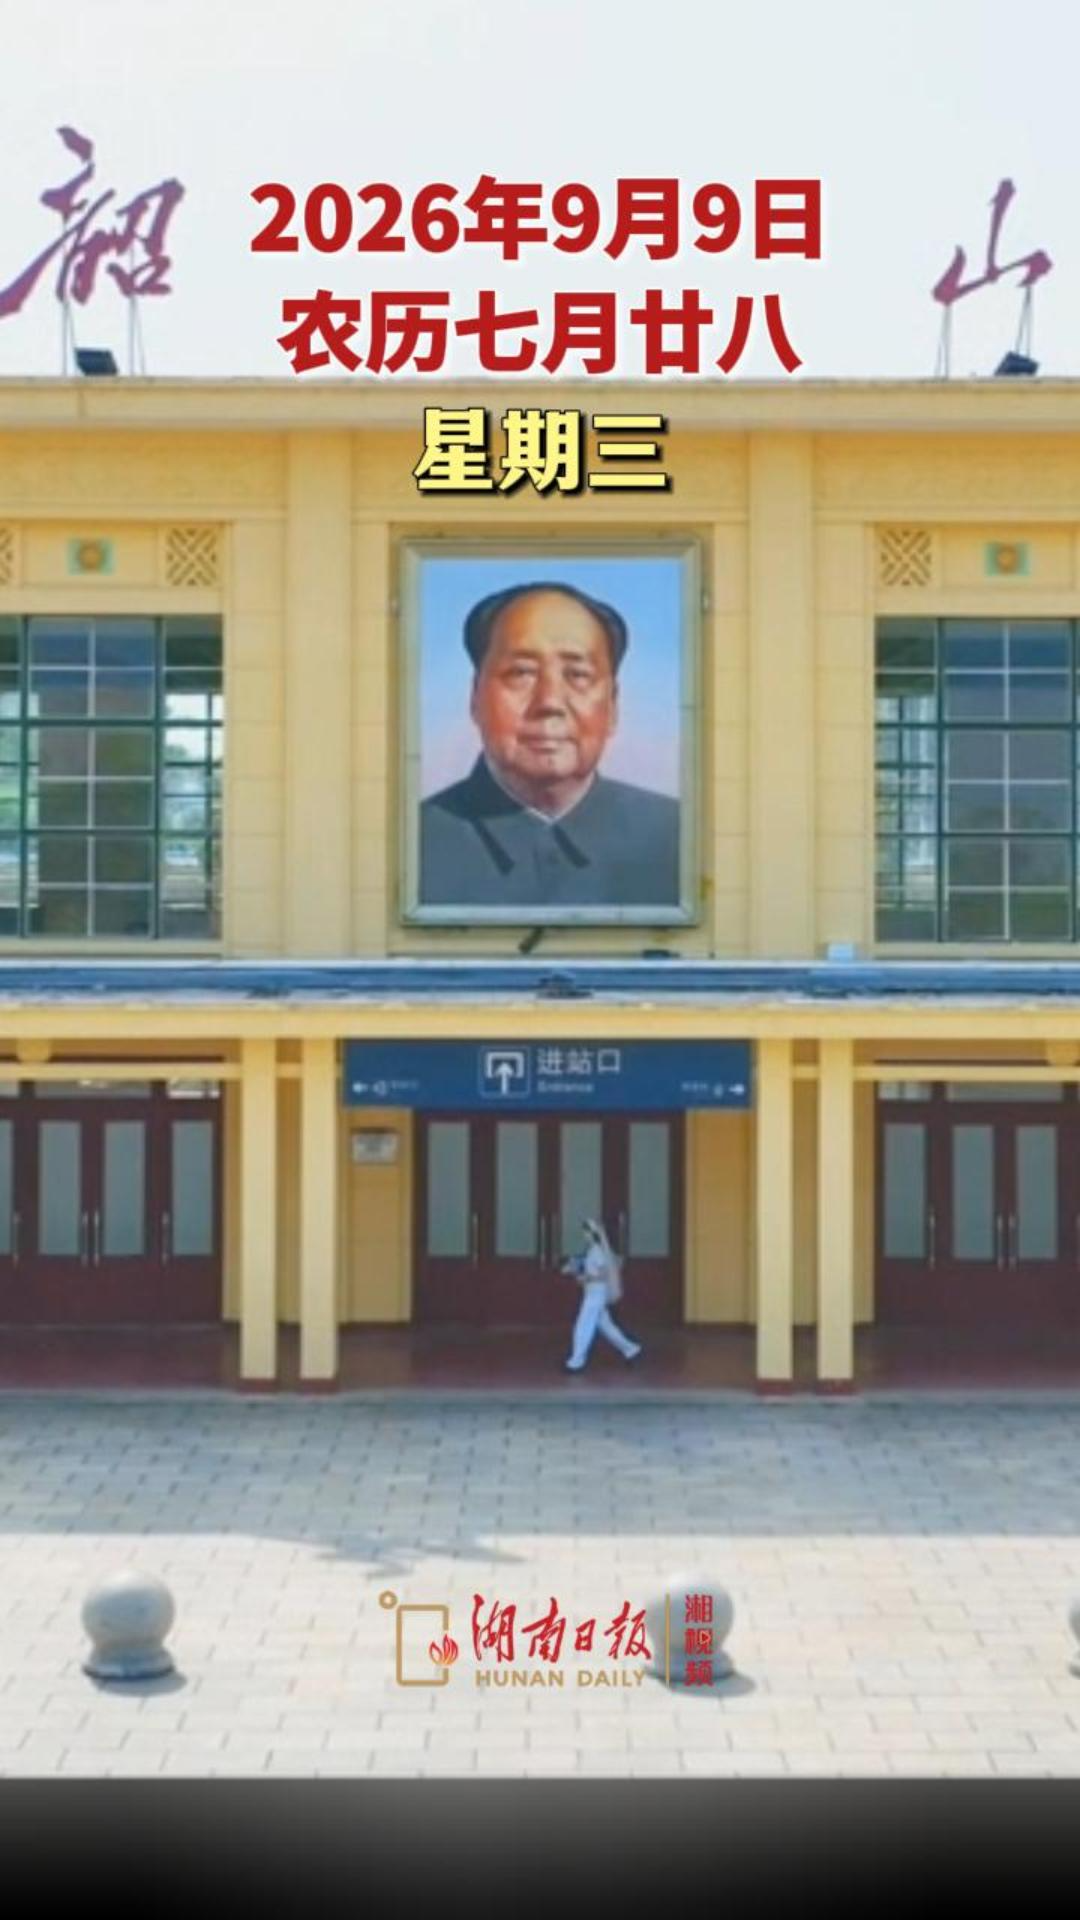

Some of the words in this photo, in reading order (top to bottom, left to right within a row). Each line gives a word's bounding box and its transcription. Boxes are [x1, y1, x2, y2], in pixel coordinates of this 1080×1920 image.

[0, 126, 185, 318] 韶
[931, 177, 1054, 306] 山
[536, 1048, 622, 1075] 进站口
